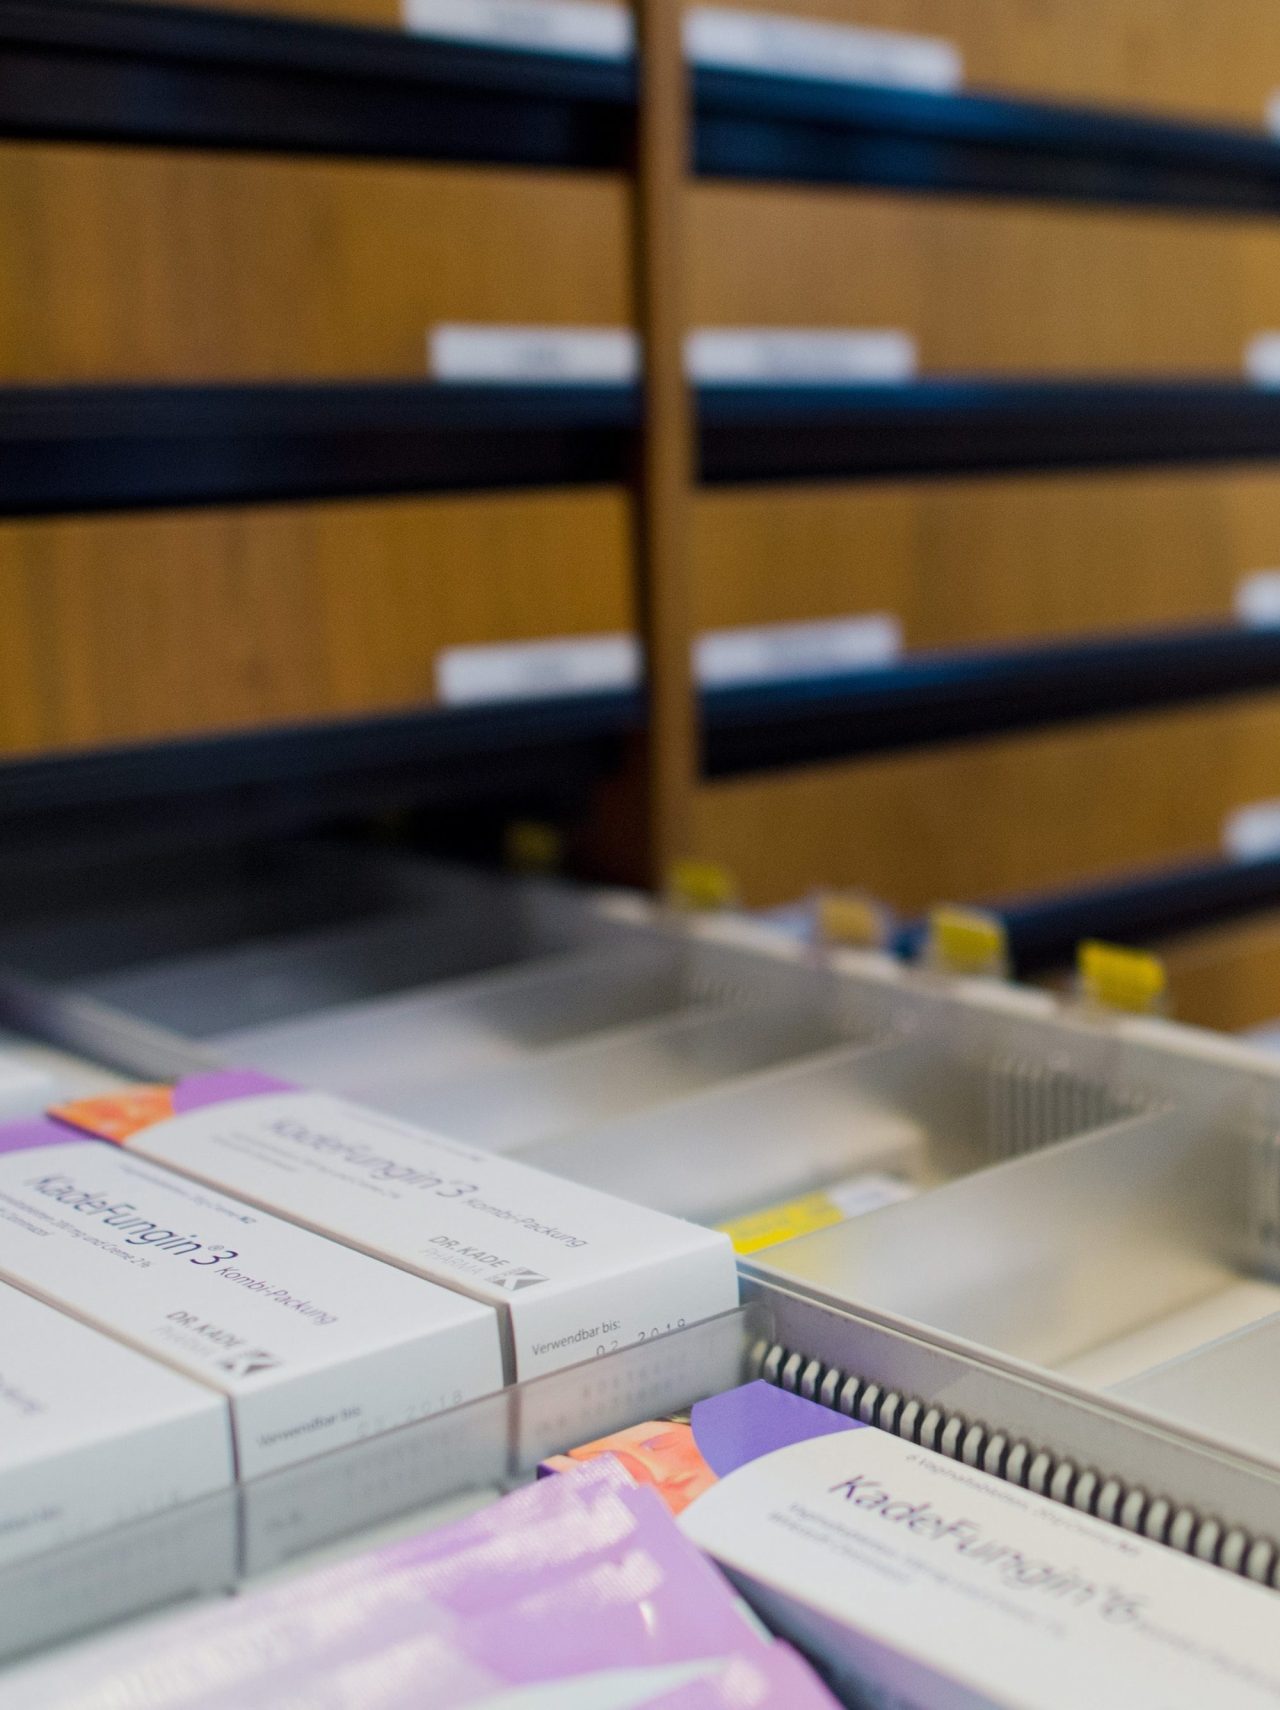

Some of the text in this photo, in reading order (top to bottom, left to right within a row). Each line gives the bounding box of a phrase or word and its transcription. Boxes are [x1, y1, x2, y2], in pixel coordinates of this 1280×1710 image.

[462, 1197, 589, 1248] Kombi-Packung
[455, 1245, 510, 1270] KADE
[214, 1266, 338, 1326] Kombi-Packung
[531, 1319, 621, 1356] Verwendbar bis:
